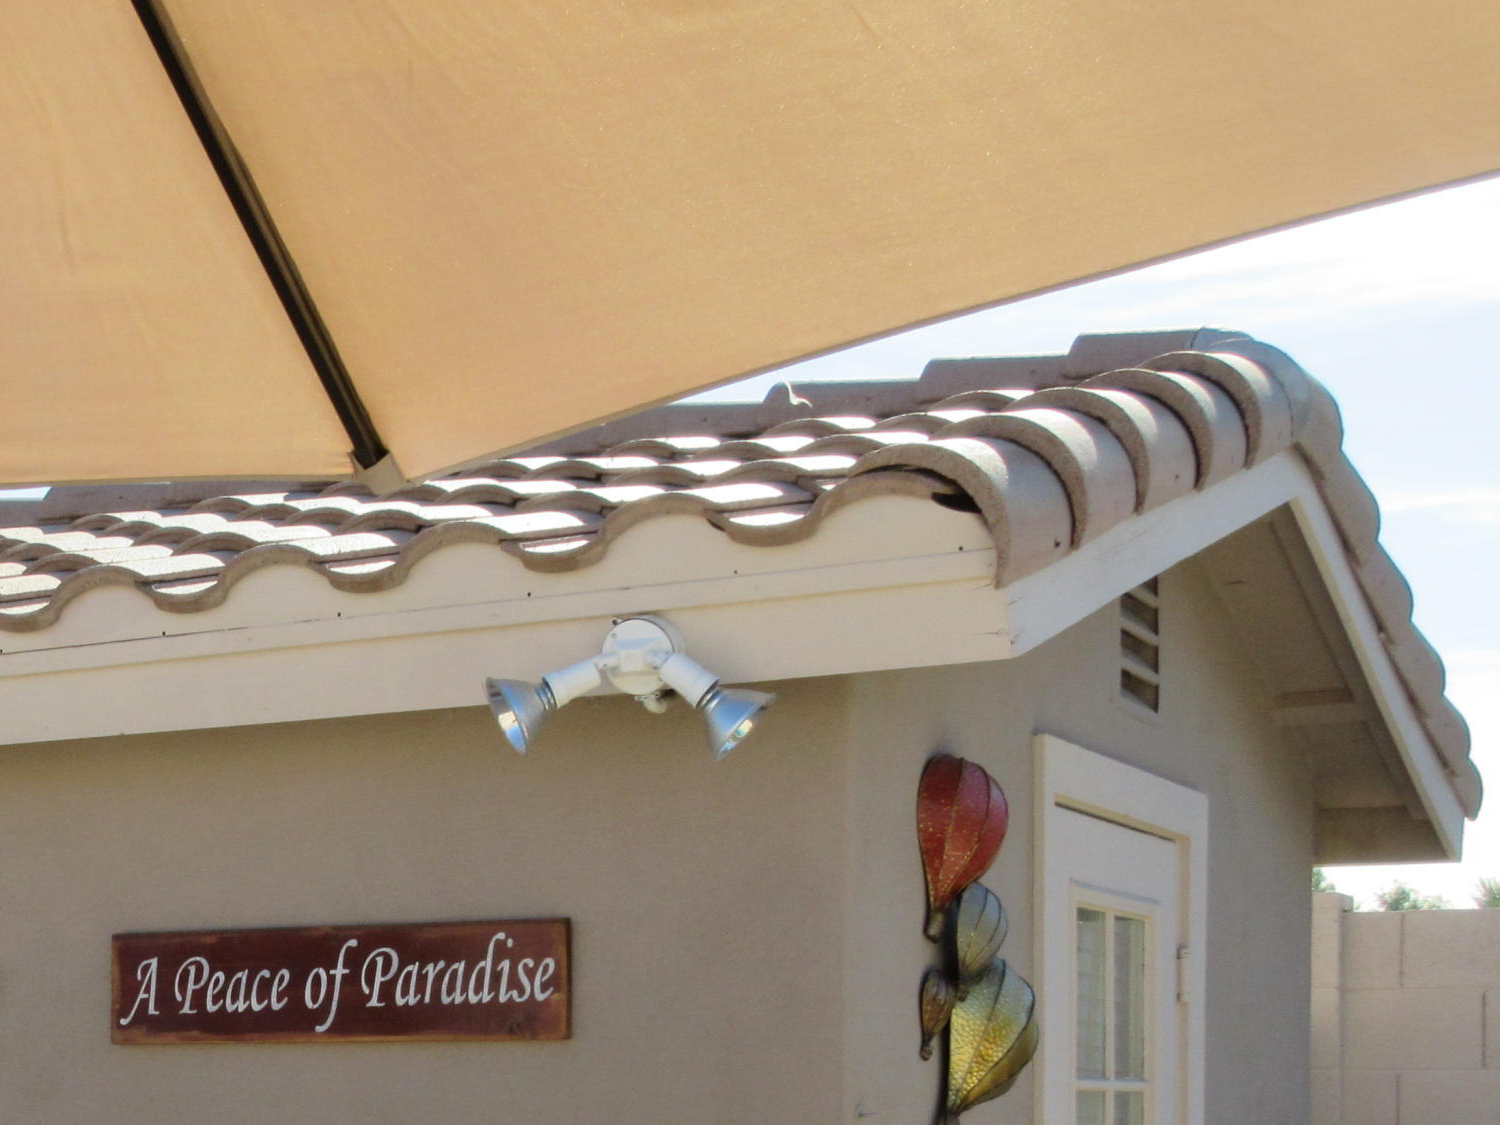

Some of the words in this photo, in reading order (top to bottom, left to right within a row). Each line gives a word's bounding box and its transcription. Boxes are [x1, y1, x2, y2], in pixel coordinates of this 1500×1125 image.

[119, 956, 161, 1026] A
[173, 955, 290, 1014] Peace
[303, 938, 359, 1033] of
[360, 931, 556, 1007] Paradise
